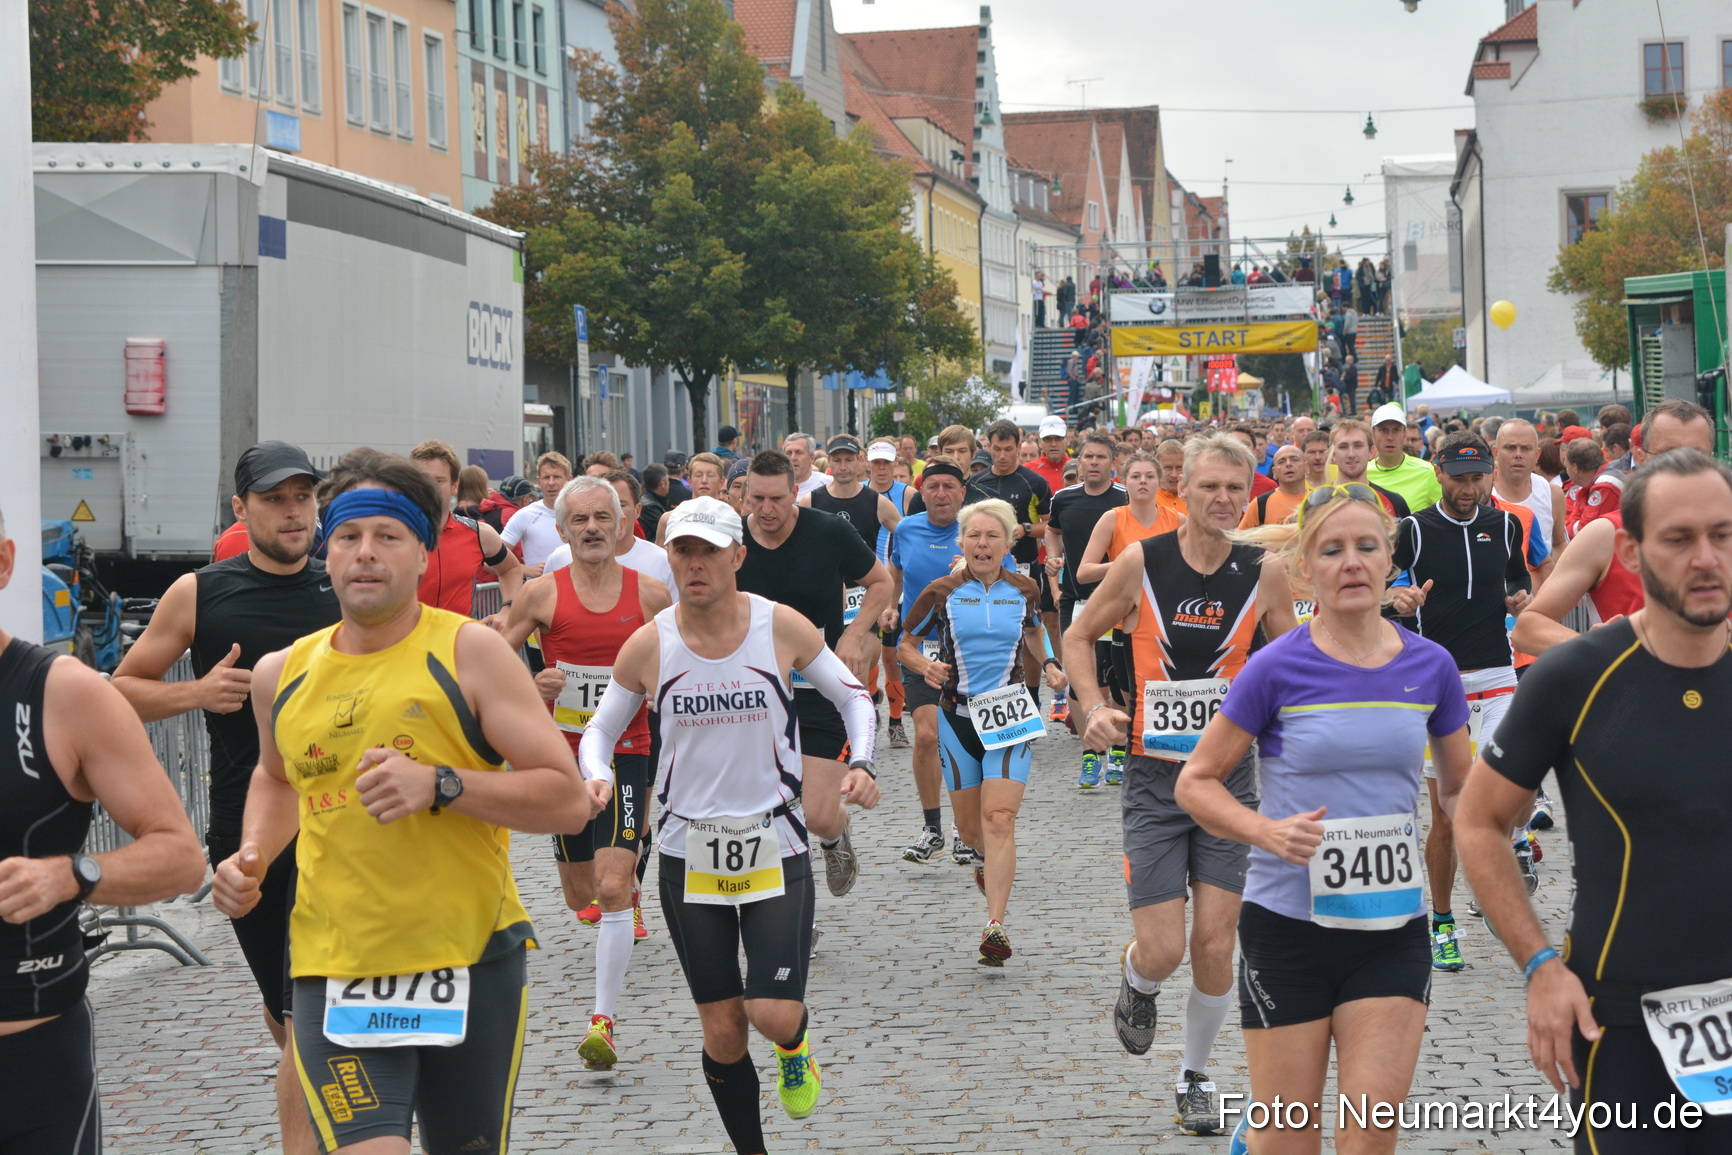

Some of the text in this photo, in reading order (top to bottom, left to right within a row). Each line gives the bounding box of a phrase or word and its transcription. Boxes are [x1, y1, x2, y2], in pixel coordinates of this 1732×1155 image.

[1196, 295, 1275, 306] EfficientDyamics
[467, 302, 512, 369] BOCK
[1179, 329, 1249, 348] START
[695, 680, 741, 693] TEAM
[1145, 687, 1217, 697] PARTL Neumarkt
[672, 690, 768, 716] ERDINGER
[969, 690, 1018, 708] PARTL Neumarkt
[675, 712, 768, 728] ALKOHOLFREI
[977, 698, 1033, 731] 2642
[15, 702, 40, 779] 2XU
[329, 728, 364, 740] NEUMARKT
[395, 737, 411, 746] Esso
[996, 726, 1028, 741] Marion
[1149, 736, 1197, 753] Rein
[293, 753, 340, 773] NEUMARKTER
[319, 791, 333, 808] &
[337, 788, 347, 805] S
[689, 821, 760, 836] PARTL Neumarkt
[1320, 826, 1402, 841] ARTL Neumarkt
[706, 835, 761, 872] 187
[1322, 842, 1413, 889] 3403
[717, 879, 751, 893] Klaus
[16, 954, 64, 974] 2XU
[341, 967, 456, 1004] 2078
[1253, 980, 1276, 1010] odlo
[366, 1012, 421, 1030] Alfred
[1667, 1010, 1732, 1068] 20
[336, 1060, 372, 1105] Run!
[330, 1085, 349, 1119] Team
